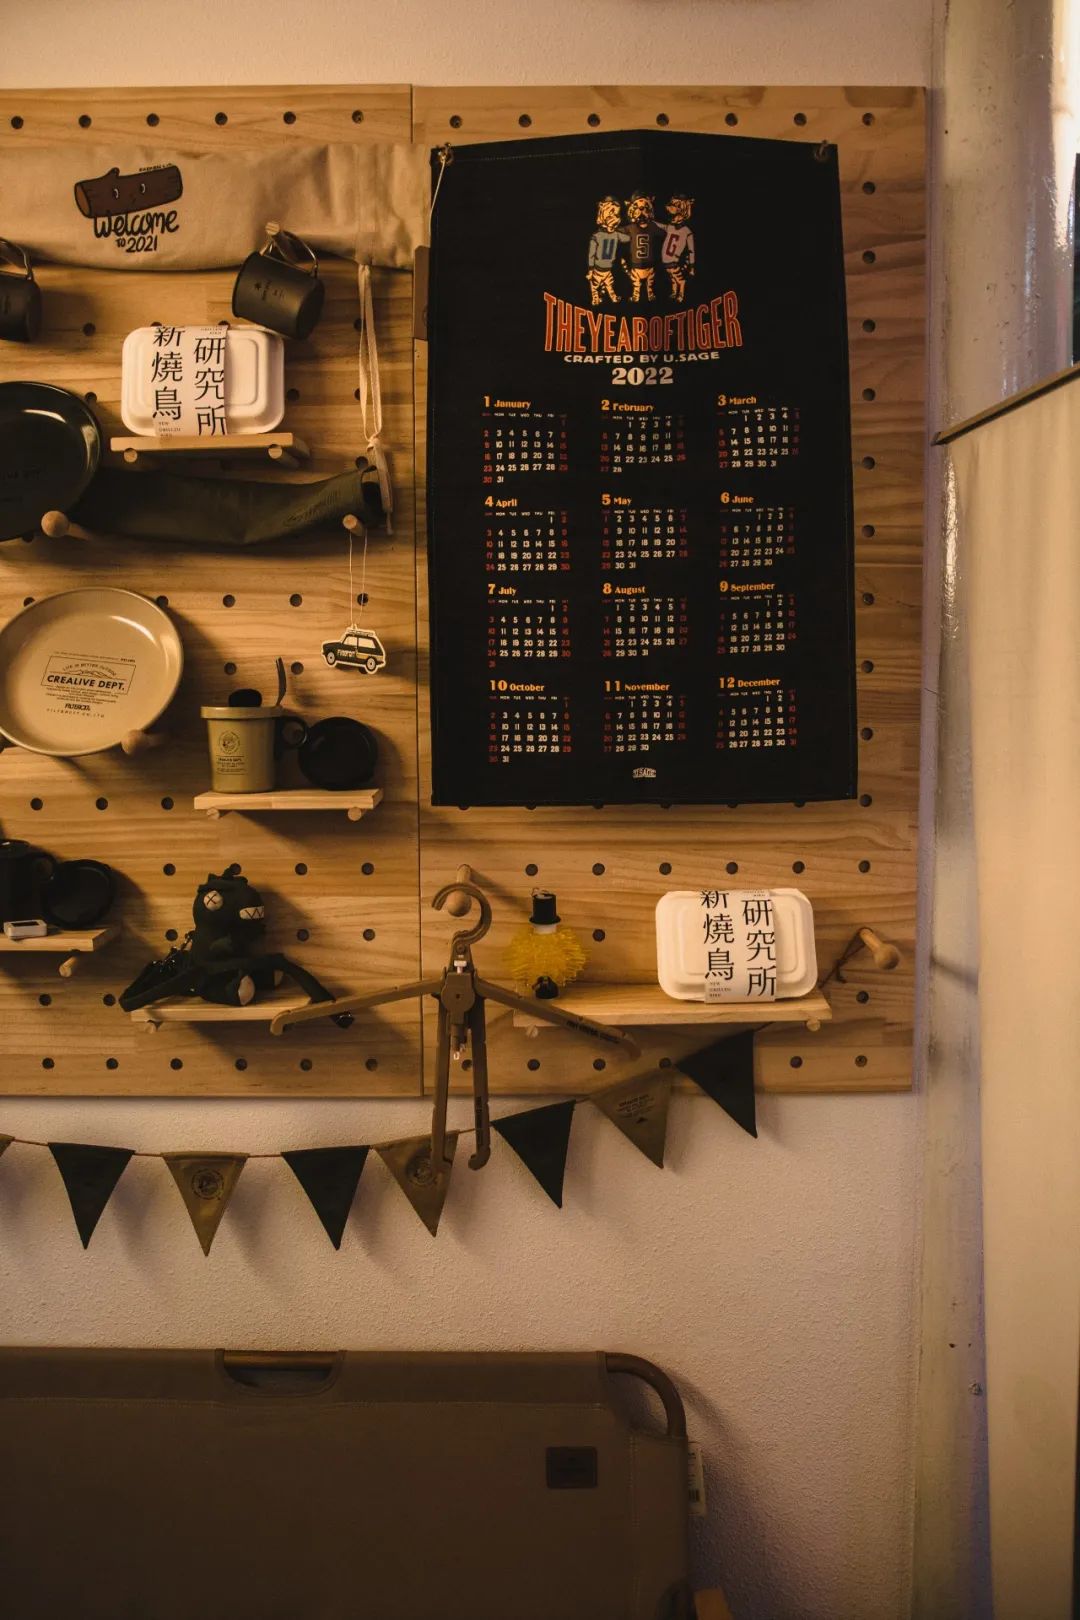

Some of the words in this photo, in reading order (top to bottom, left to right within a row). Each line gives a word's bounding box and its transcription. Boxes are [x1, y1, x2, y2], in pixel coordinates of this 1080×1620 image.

[93, 210, 180, 238] Welcome
[126, 235, 158, 253] 2021
[602, 239, 615, 260] U
[666, 234, 680, 256] G
[564, 354, 634, 364] CRAFTED
[640, 354, 658, 363] BY
[663, 351, 720, 362] U.SAGE
[612, 366, 674, 385] 2022
[194, 337, 226, 436] 研究所
[484, 396, 490, 407] 1
[494, 400, 531, 409] January
[601, 399, 610, 411] 2
[613, 403, 653, 412] February
[718, 394, 727, 406] 3
[729, 396, 757, 405] March
[485, 496, 494, 507] 4
[496, 498, 517, 508] April
[602, 494, 611, 505] 5
[614, 497, 631, 505] May
[720, 492, 730, 504] 6
[732, 495, 754, 503] June
[488, 583, 496, 594] 7
[498, 587, 516, 596] July
[603, 583, 612, 594] 8
[615, 586, 645, 595] August
[720, 581, 729, 592] 9
[730, 583, 775, 592] September
[47, 675, 95, 686] CREALIVE
[98, 680, 124, 690] DEPT.
[490, 680, 508, 691] 10
[509, 683, 545, 692] October
[605, 680, 620, 692] 11
[720, 677, 735, 688] 12
[737, 678, 780, 688] December
[741, 899, 776, 996] 研究所
